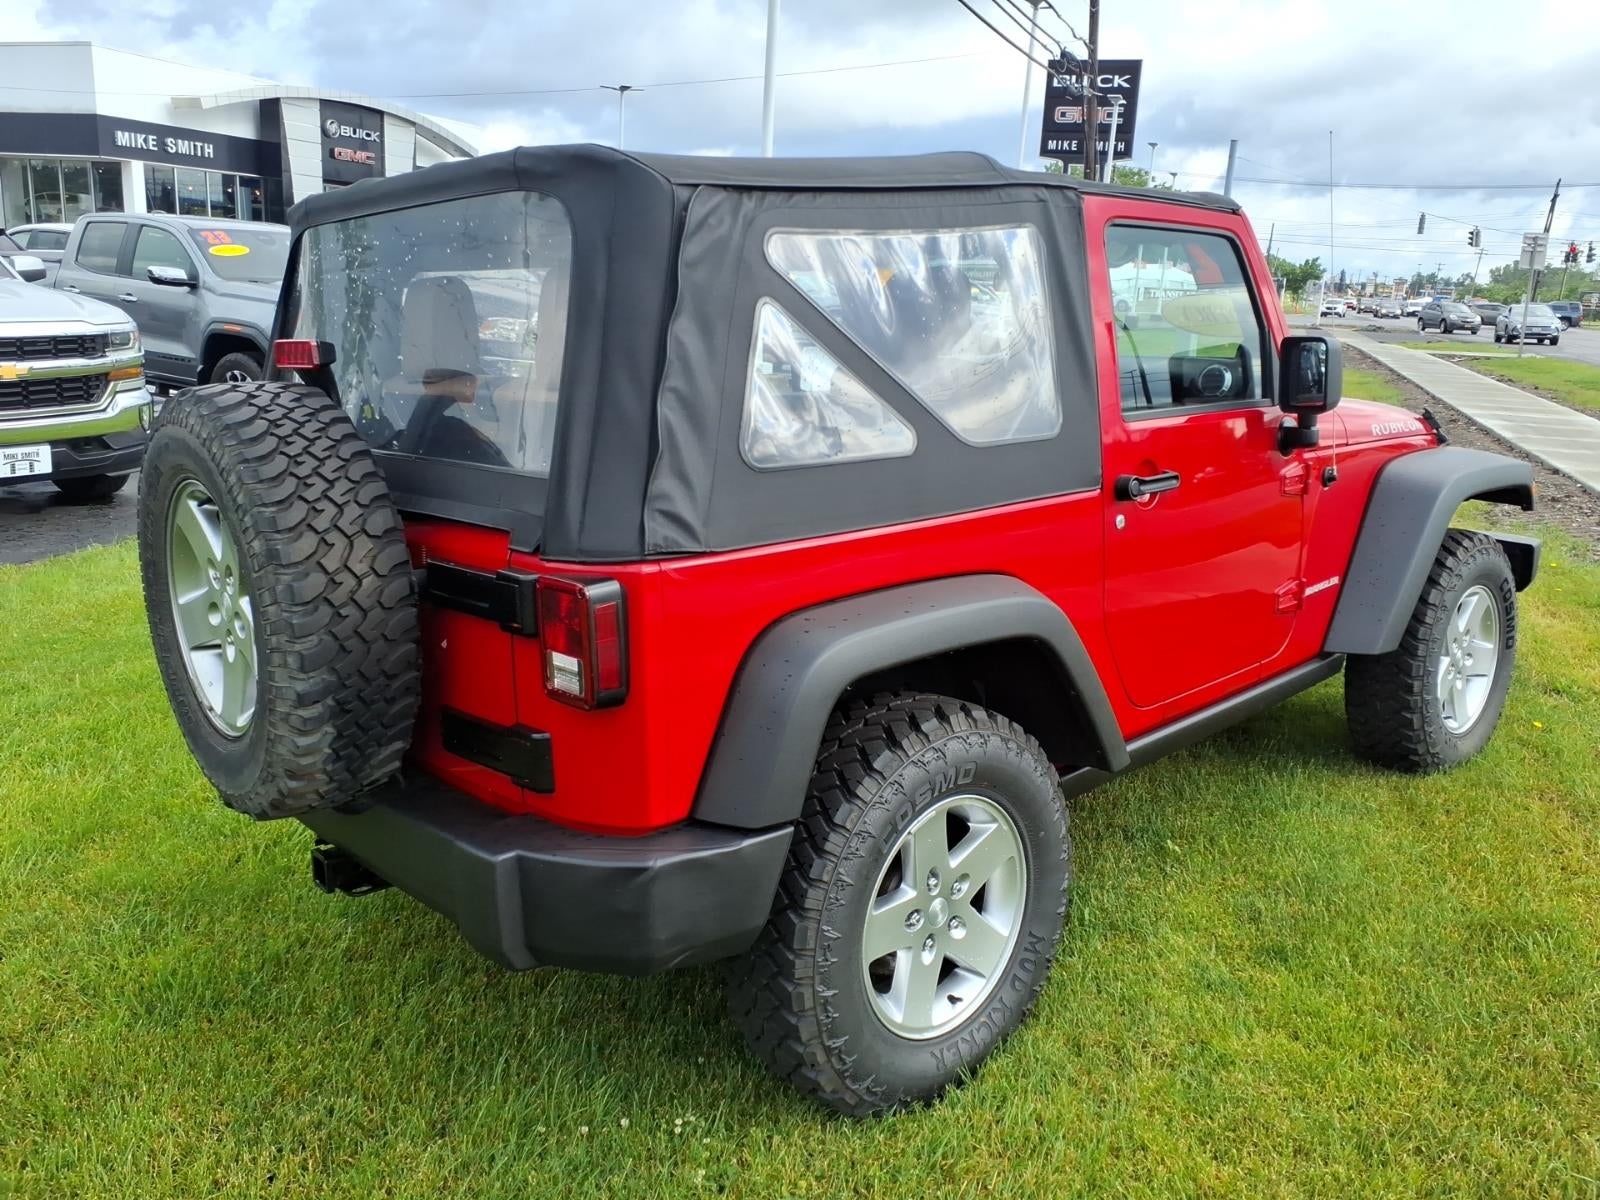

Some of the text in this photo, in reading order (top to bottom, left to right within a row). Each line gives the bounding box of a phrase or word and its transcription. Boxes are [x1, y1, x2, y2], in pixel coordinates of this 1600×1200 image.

[1053, 74, 1132, 88] BUCK
[340, 125, 380, 143] BUICK
[115, 130, 214, 159] MIKE SMITH
[1048, 139, 1078, 151] MIKE
[334, 147, 376, 165] GMC
[3, 453, 19, 461] MIKE
[1500, 577, 1515, 650] COSMO
[1007, 930, 1046, 992] MUD
